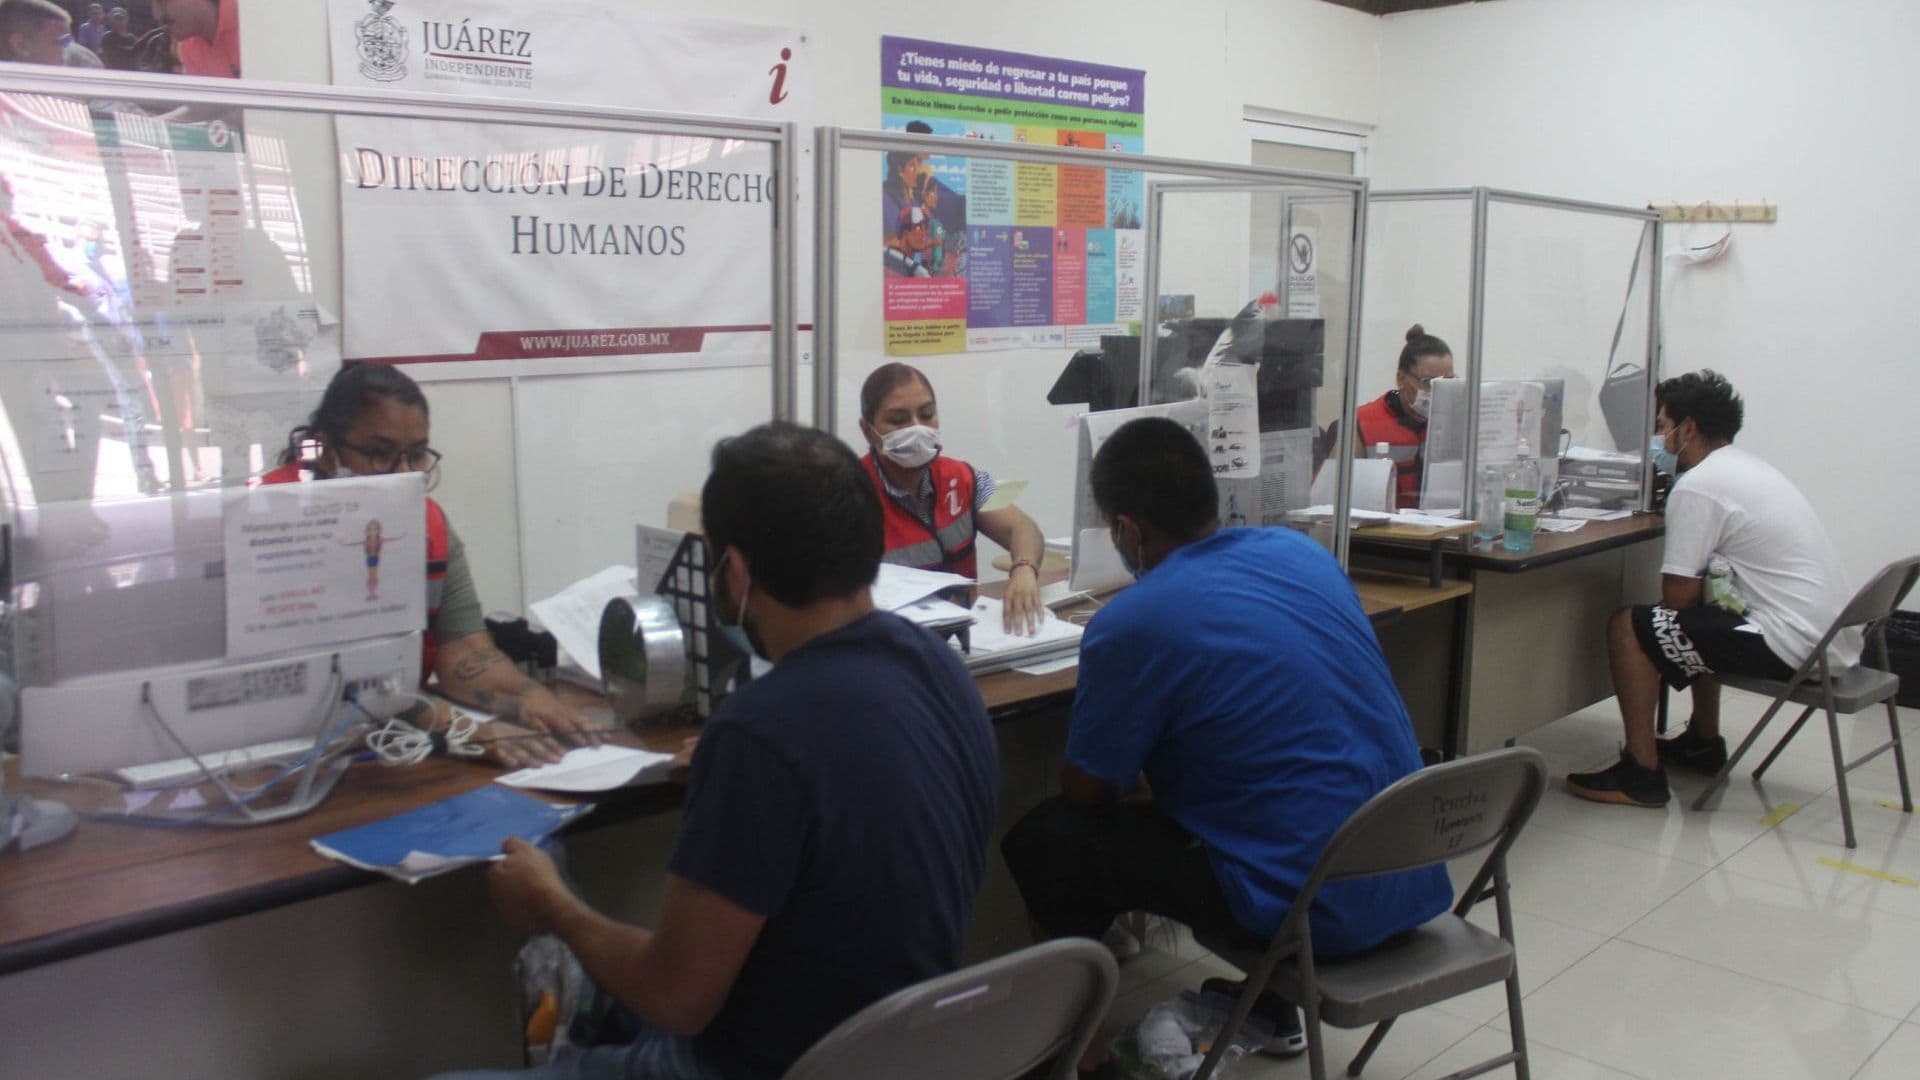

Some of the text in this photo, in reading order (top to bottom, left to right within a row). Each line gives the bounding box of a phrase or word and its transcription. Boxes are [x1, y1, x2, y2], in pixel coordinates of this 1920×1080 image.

[422, 18, 532, 58] JUÁREZ
[424, 58, 534, 80] INDEPENDIENTE
[897, 69, 1130, 108] tu vida, seguridad o libertad corren peligro?
[900, 51, 1128, 92] ¿Tienes miedo de regresar a tu país porque
[355, 147, 799, 203] DIRECCIÓN DE DERECH
[510, 215, 687, 257] HUMANOS
[519, 333, 670, 351] WWW.JUAREZ.GOB.MX
